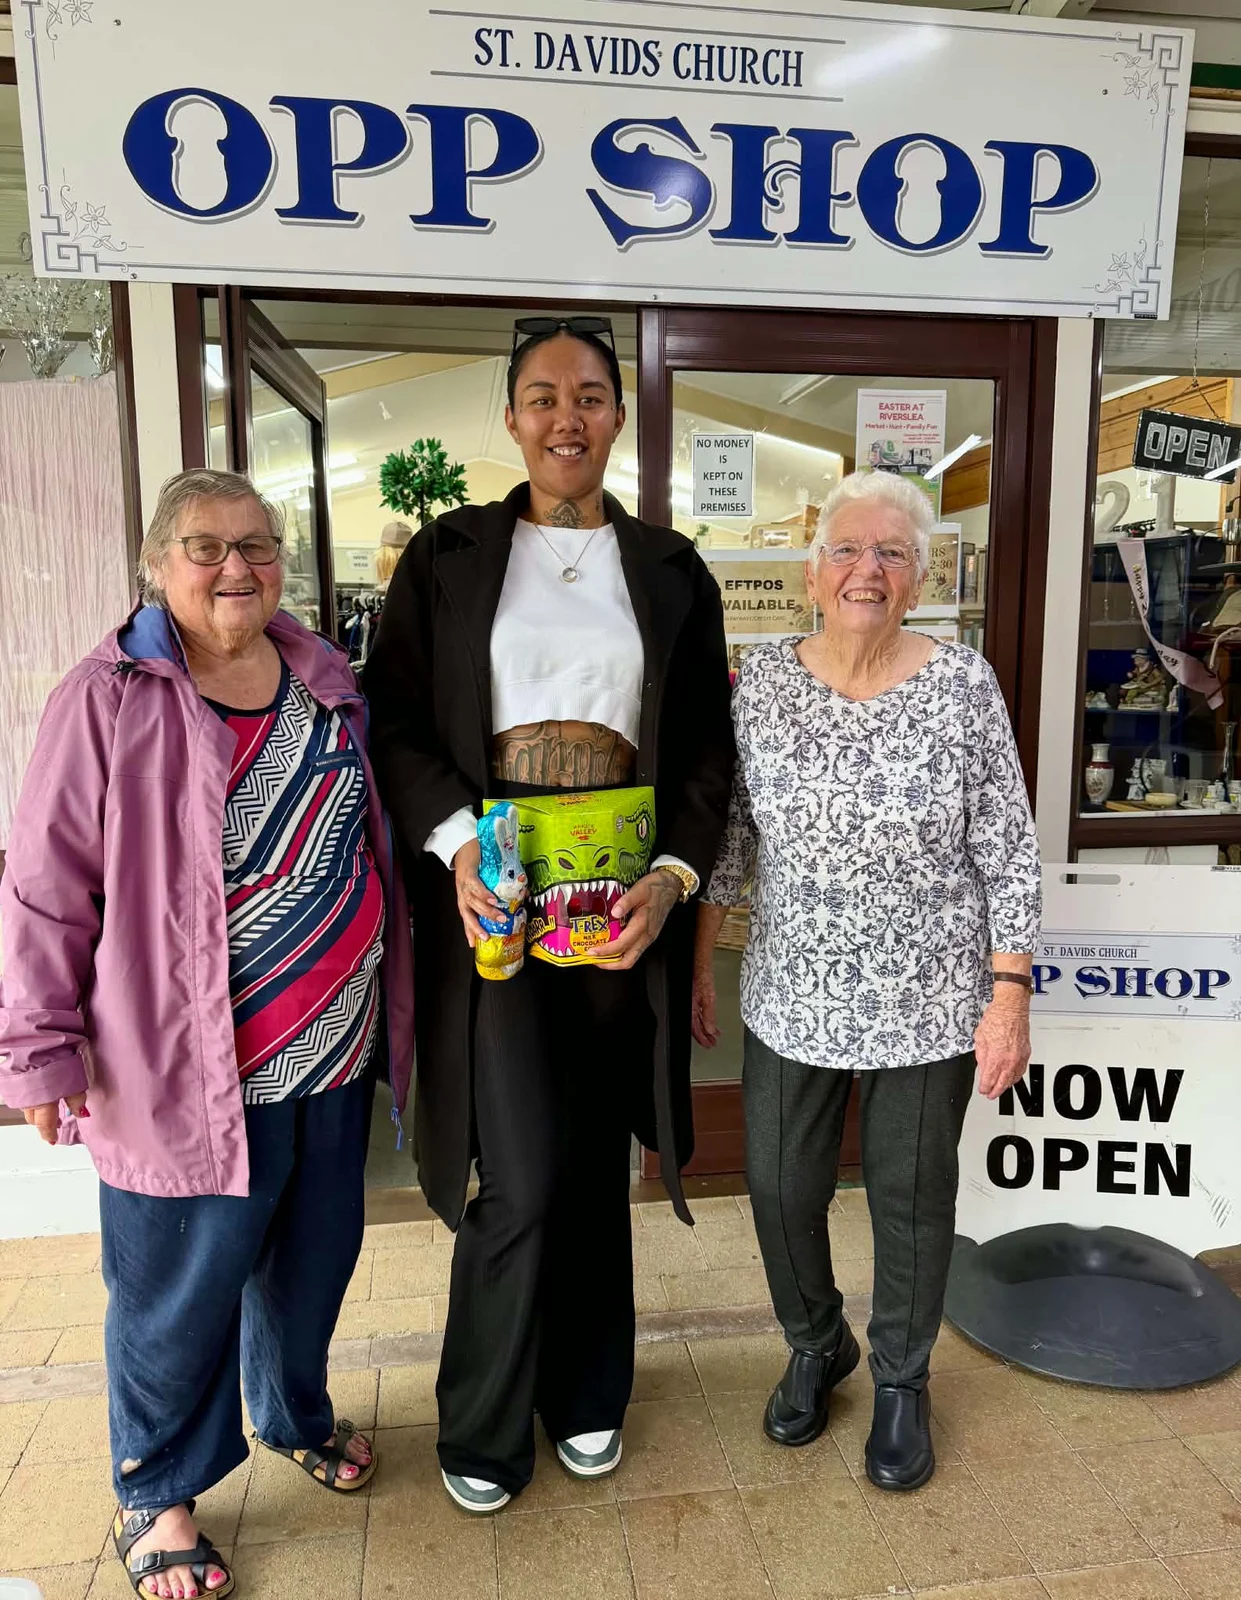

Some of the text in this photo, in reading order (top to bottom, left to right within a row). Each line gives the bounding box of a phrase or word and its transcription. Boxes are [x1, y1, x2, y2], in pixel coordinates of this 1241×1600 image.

[474, 27, 804, 88] ST. DAVIDS CHURCH
[122, 87, 1099, 260] OPP SHOP
[878, 402, 925, 411] EASTER AT
[879, 412, 924, 421] RIVERSLEA
[696, 439, 750, 448] NO MONEY
[1144, 421, 1232, 470] OPEN
[719, 454, 728, 464] IS
[703, 471, 743, 480] KEPT ON
[708, 487, 737, 496] THESE
[700, 502, 746, 512] PREMISES
[725, 580, 784, 591] EFTPOS
[723, 599, 796, 611] VAILABLE
[569, 915, 609, 933] T-REX
[572, 938, 607, 947] CHOCOLATE
[1043, 946, 1138, 958] ST. DAVIDS CHURCH
[1074, 965, 1232, 1001] SHOP
[998, 1063, 1184, 1123] NOW
[986, 1134, 1192, 1198] OPEN
